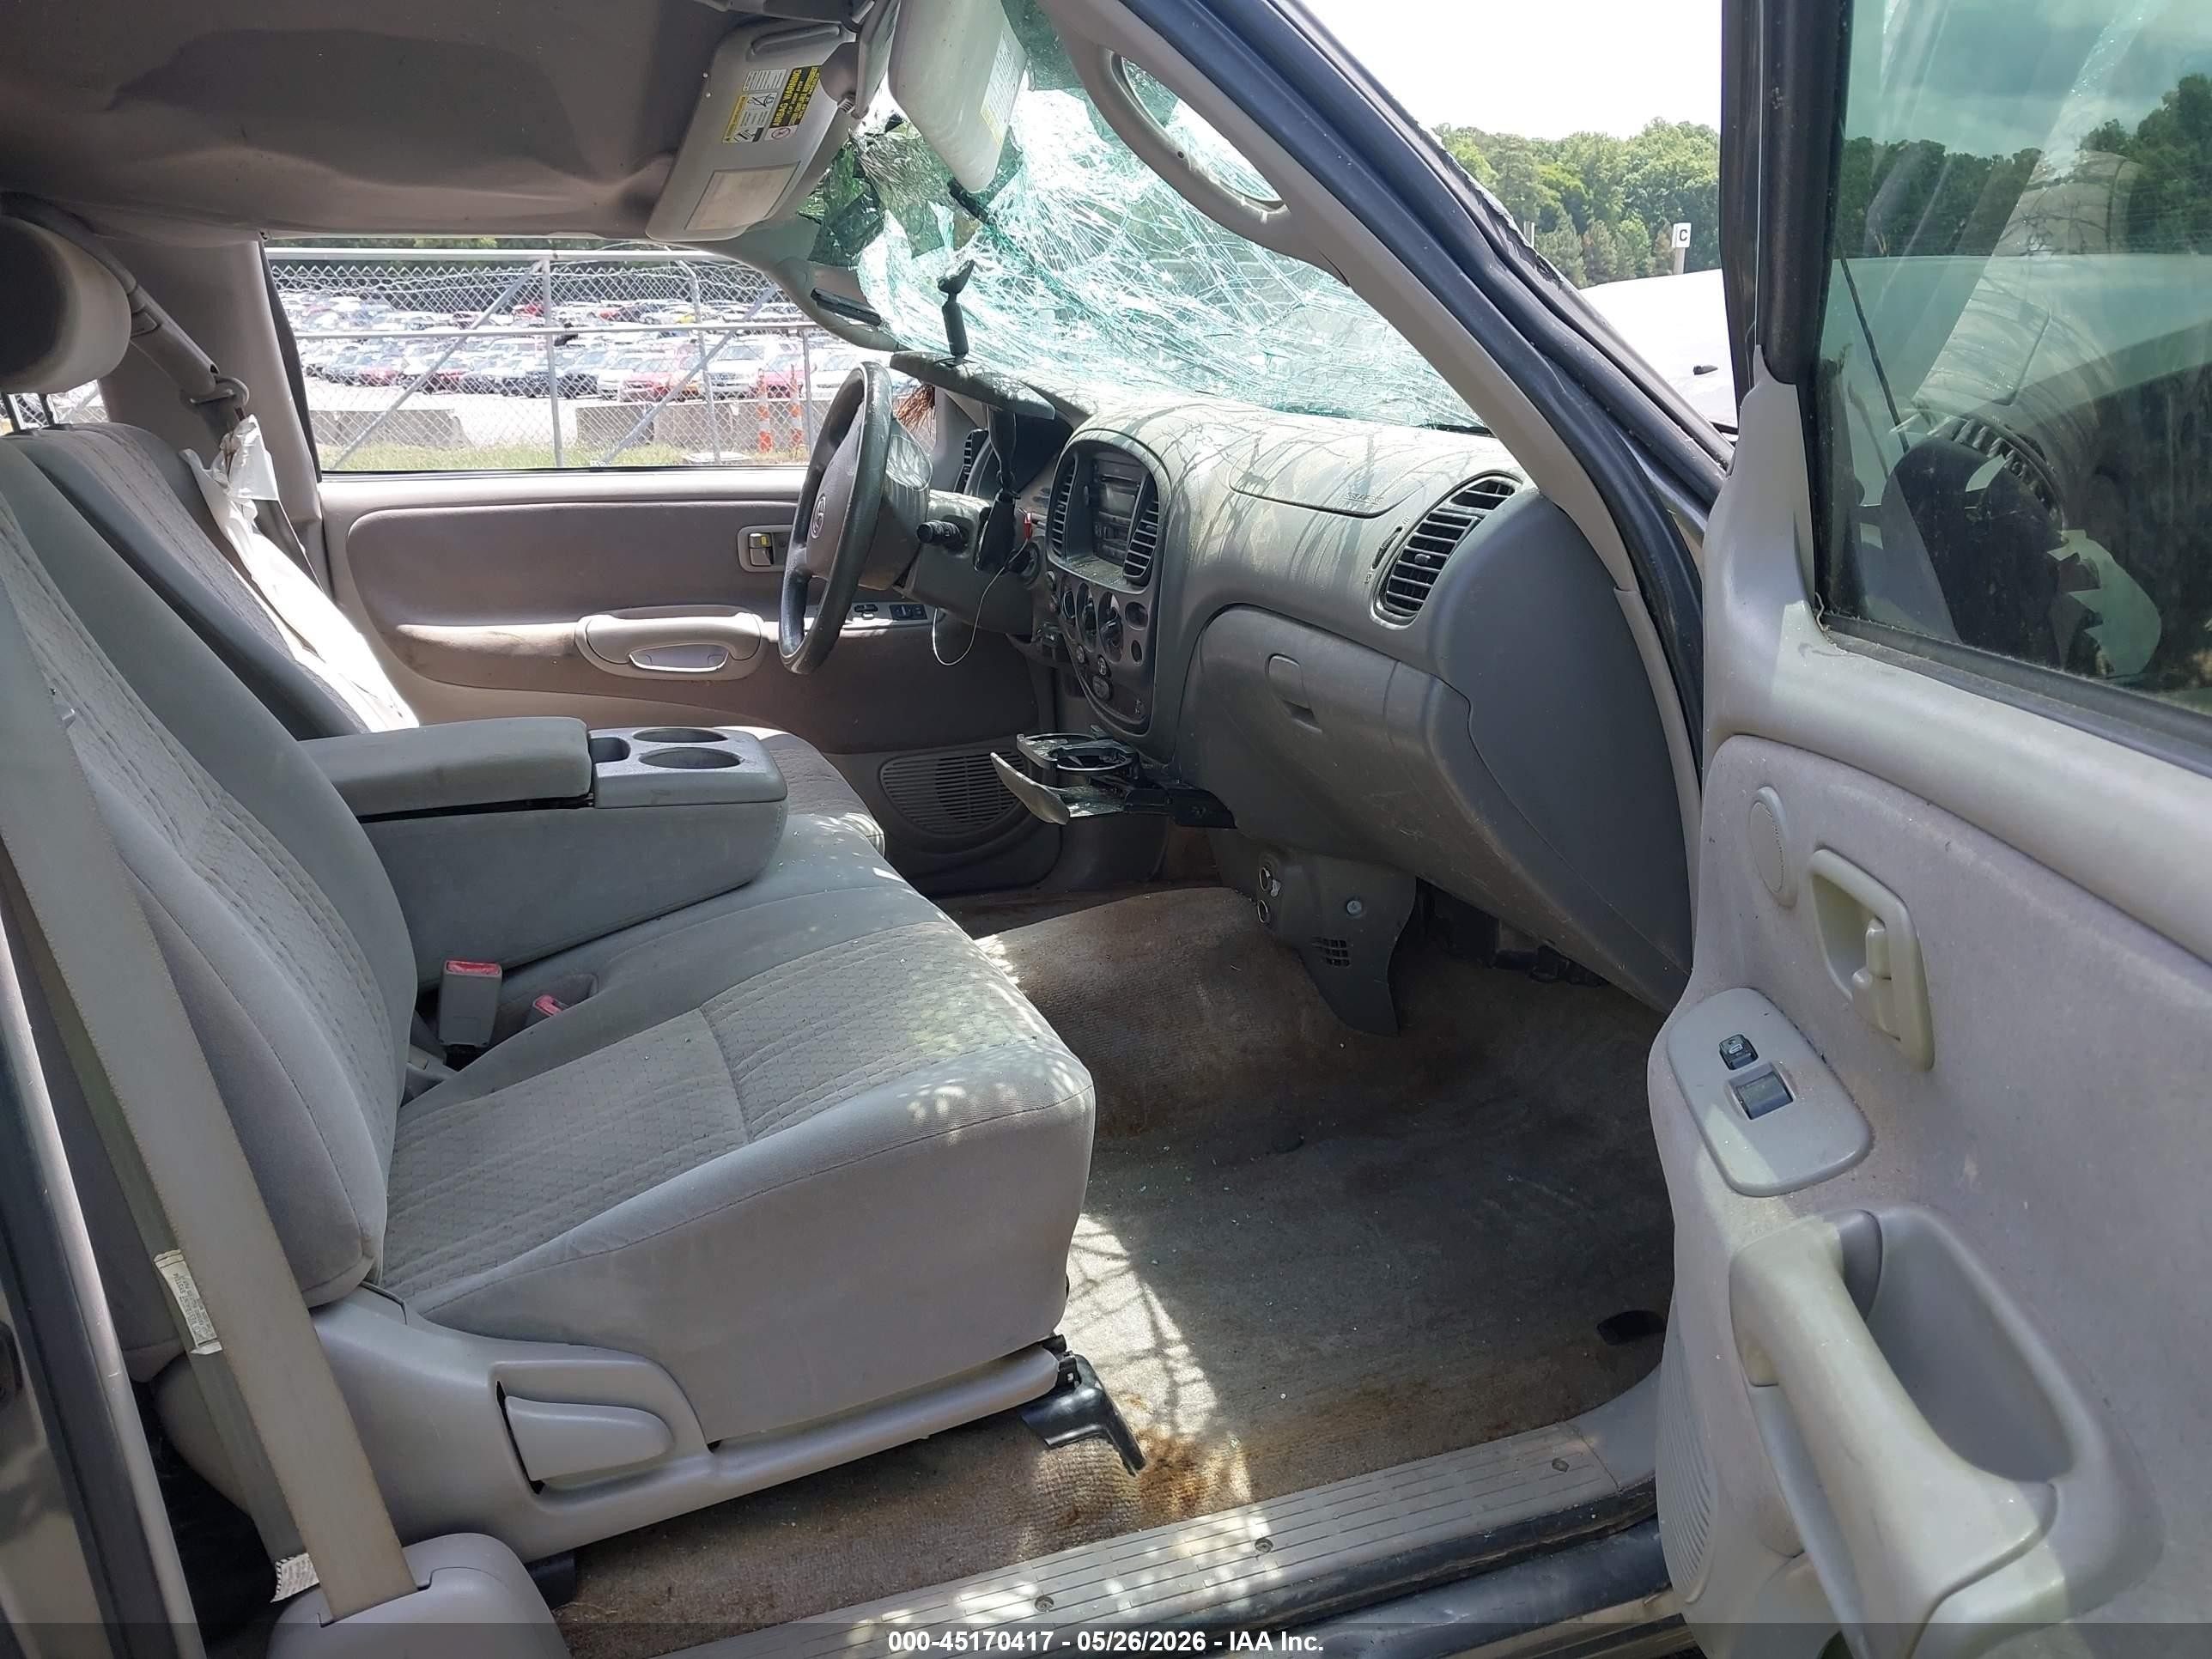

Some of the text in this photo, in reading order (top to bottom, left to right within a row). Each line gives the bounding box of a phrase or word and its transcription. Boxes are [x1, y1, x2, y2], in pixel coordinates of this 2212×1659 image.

[772, 69, 802, 126] AIRBAG WARNING
[1679, 229, 1687, 241] C
